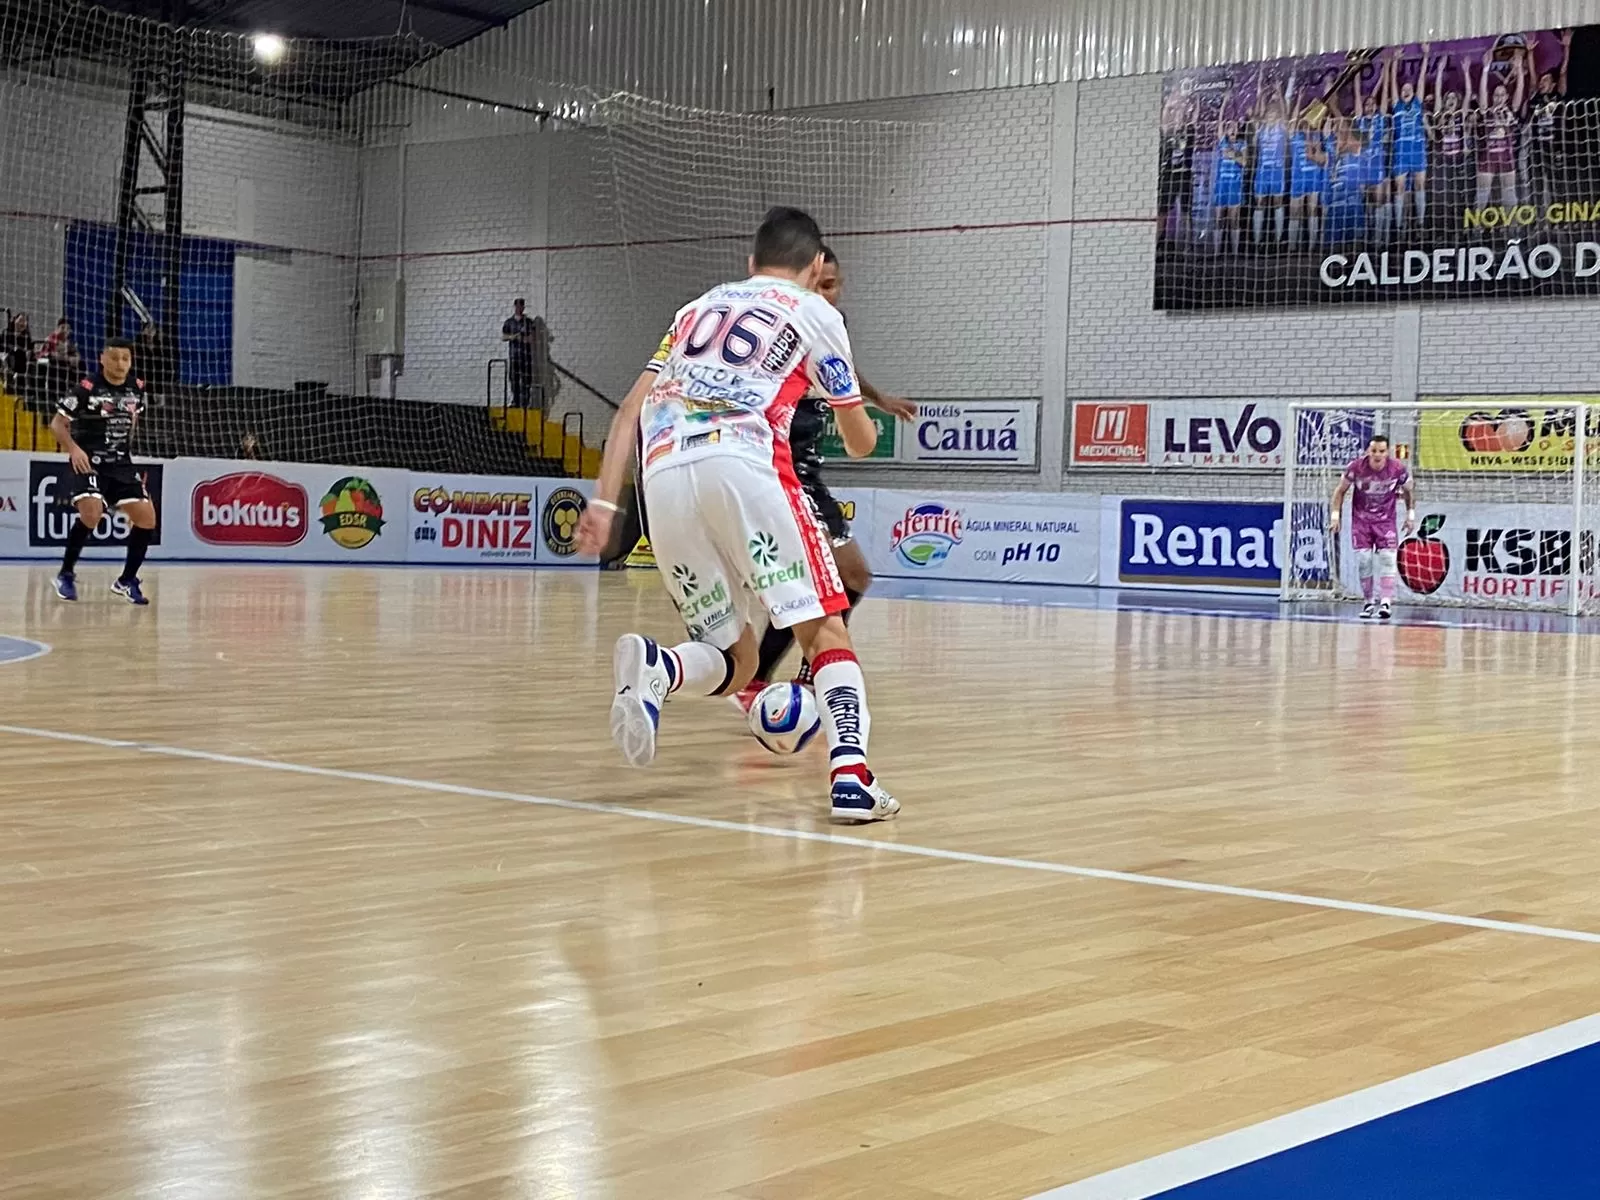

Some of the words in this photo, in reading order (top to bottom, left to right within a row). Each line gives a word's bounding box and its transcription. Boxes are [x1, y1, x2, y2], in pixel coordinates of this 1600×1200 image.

[1464, 204, 1537, 228] NOVO
[1319, 239, 1562, 287] CALDEIRÃO
[919, 405, 961, 418] Hotéis
[918, 418, 1017, 452] Caiuá
[1164, 403, 1281, 453] LEVO
[1163, 454, 1281, 465] ALIMENTOS
[414, 486, 532, 517] COMBATE
[442, 517, 532, 549] DINIZ
[993, 521, 1033, 533] MINERAL
[1036, 521, 1080, 533] NATURAL
[1128, 513, 1328, 569] Renata
[1001, 543, 1030, 566] pH
[1035, 543, 1061, 562] 10
